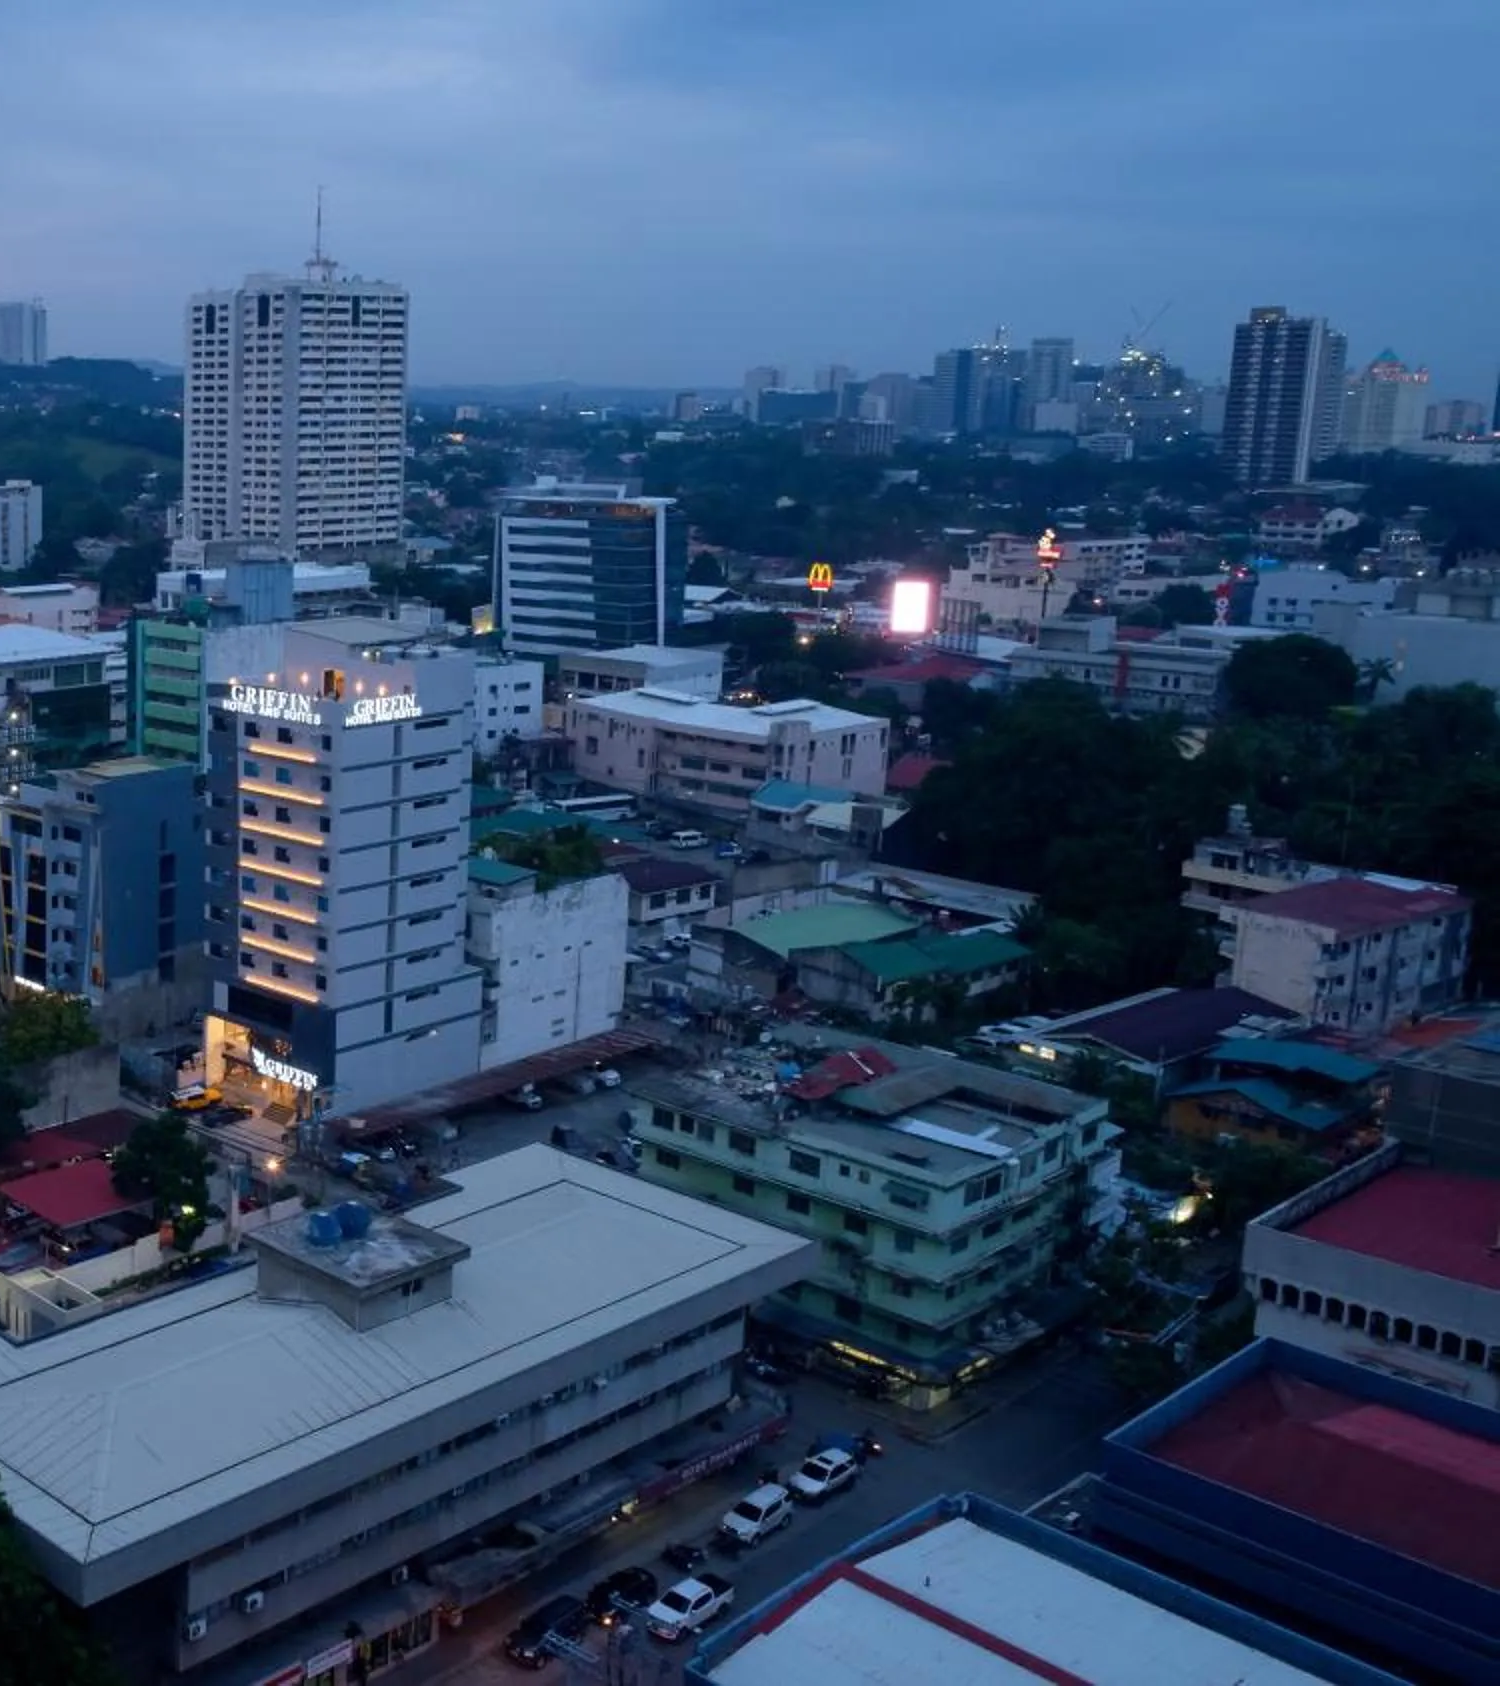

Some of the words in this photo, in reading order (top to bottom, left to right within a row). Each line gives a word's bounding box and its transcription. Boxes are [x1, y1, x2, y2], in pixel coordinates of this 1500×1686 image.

[231, 684, 311, 713] GRIFFIN
[353, 693, 417, 717] GRIFFIN
[222, 699, 255, 715] HOTEL
[258, 705, 281, 719] AND
[283, 708, 321, 725] SUITES
[345, 713, 374, 728] HOTEL
